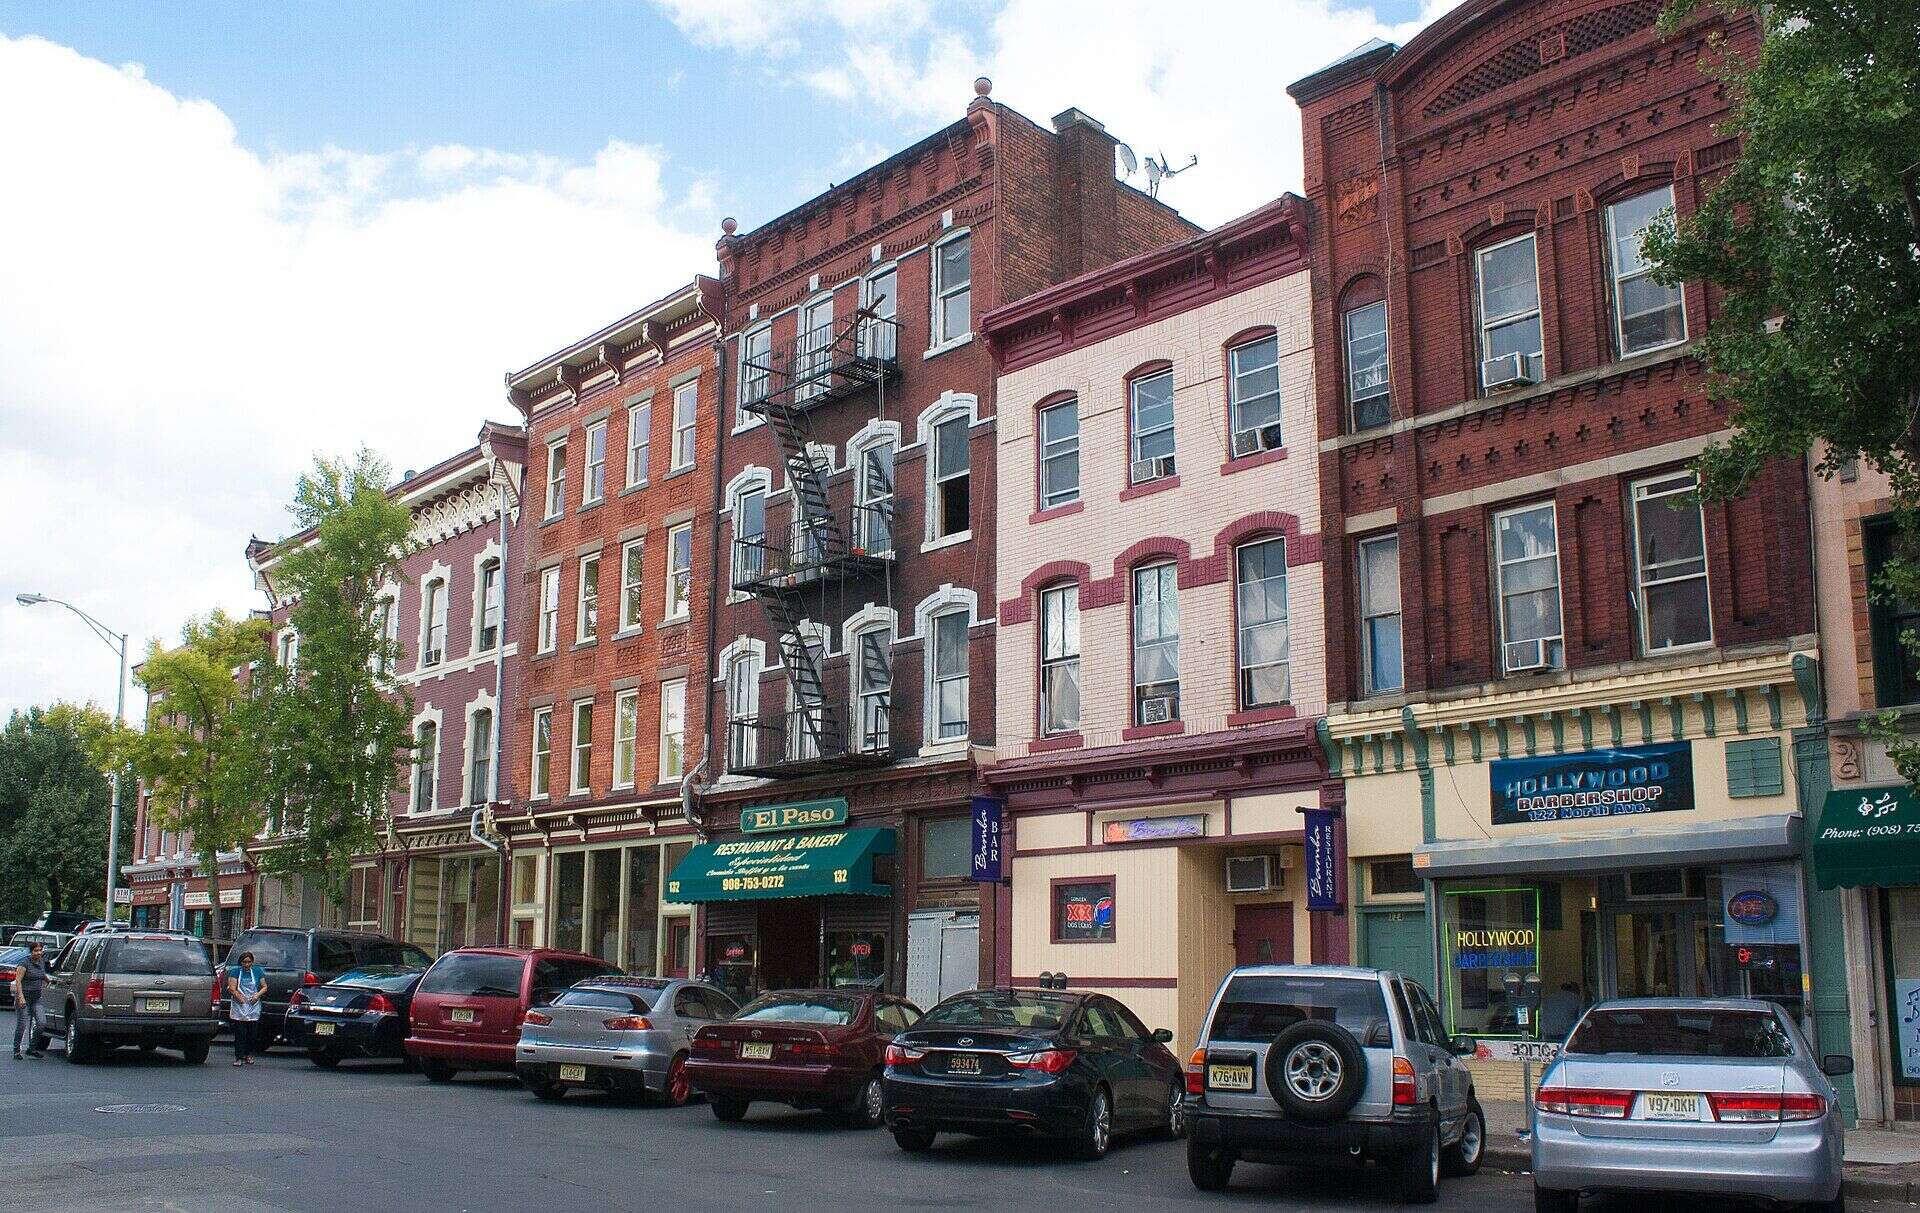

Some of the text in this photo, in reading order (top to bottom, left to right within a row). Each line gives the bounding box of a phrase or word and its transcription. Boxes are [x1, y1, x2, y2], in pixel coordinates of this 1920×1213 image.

[1506, 762, 1669, 798] HOLLYWOOD
[1517, 786, 1663, 811] BARBERSHOP
[754, 808, 835, 828] El Paso
[1528, 802, 1650, 821] 122 North Ave.
[975, 809, 988, 871] Bamba
[990, 821, 999, 862] BAR
[1820, 827, 1863, 839] Phone:
[1866, 824, 1902, 837] (908)
[713, 832, 848, 856] RESTAURANT & BAKERY
[1309, 825, 1322, 898] Bamba
[1325, 826, 1335, 899] RESTAURANT
[722, 875, 785, 891] 908-753-0272
[833, 868, 848, 883] 132
[669, 881, 680, 893] 132
[1457, 930, 1534, 947] HOLLYWOOD
